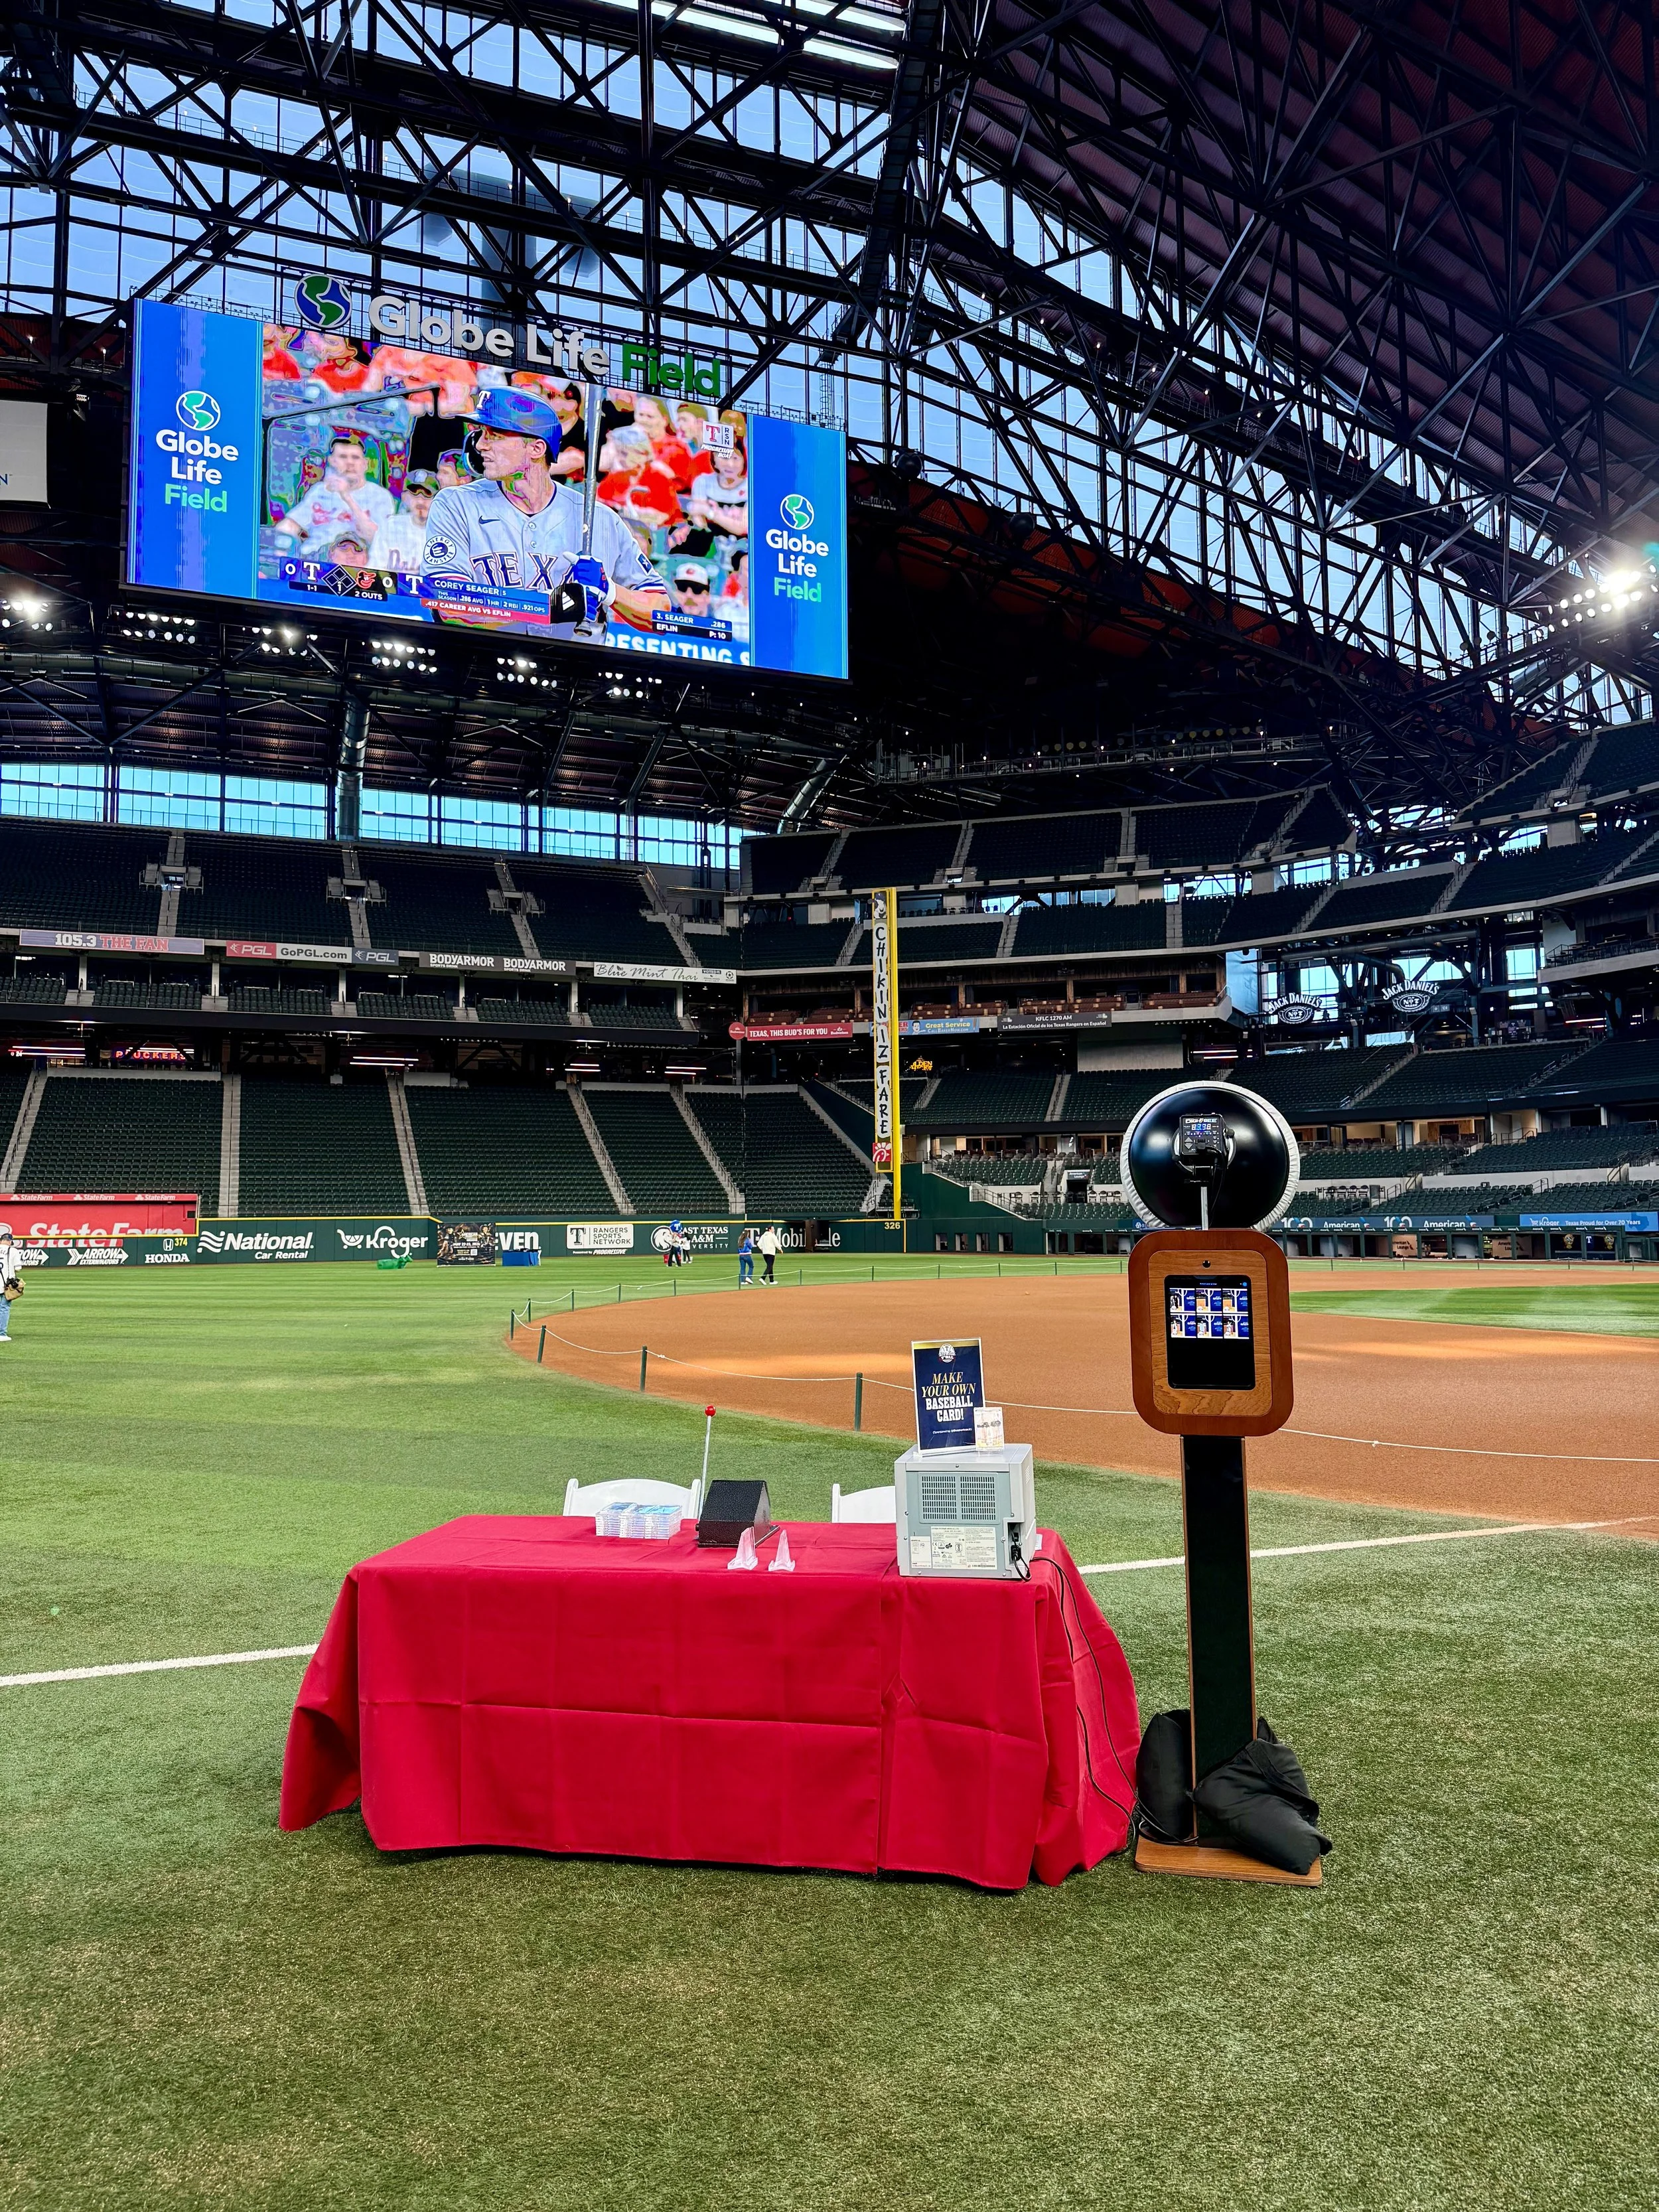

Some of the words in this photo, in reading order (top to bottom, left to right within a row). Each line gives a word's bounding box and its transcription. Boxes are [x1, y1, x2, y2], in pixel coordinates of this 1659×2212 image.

[368, 295, 515, 357] Globe
[527, 323, 610, 376] Life
[622, 342, 721, 398] Field
[476, 390, 491, 409] T
[705, 425, 721, 443] T
[156, 429, 239, 461] Globe
[171, 456, 222, 484] Life
[165, 483, 228, 512] Field
[426, 536, 454, 552] ENERGY
[765, 528, 830, 557] Globe
[425, 552, 455, 565] TRANSFER
[778, 553, 818, 578] Life
[285, 563, 296, 575] 0
[303, 561, 321, 581] T
[470, 552, 575, 590] TEX
[382, 576, 393, 588] 0
[405, 575, 423, 595] T
[434, 579, 464, 591] COREY
[466, 583, 499, 595] SEAGER
[361, 591, 383, 601] OUTS
[774, 577, 822, 603] Field
[439, 603, 467, 611] CAREER
[665, 614, 694, 624] SEAGER
[656, 623, 678, 632] EFLIN
[55, 933, 97, 947] 105.3
[100, 935, 132, 949] THE
[135, 936, 169, 951] FAN
[241, 944, 273, 956] PGL
[281, 947, 348, 960] GoPGL.com
[366, 952, 396, 963] PGL
[429, 953, 494, 967] BODYARMOR
[503, 958, 566, 972] BODYARMOR
[596, 964, 628, 977] Blue
[629, 966, 668, 978] Mint
[672, 968, 699, 980] Thai
[875, 926, 887, 1020] CHIKIN
[1382, 983, 1404, 1000] JACK
[1404, 980, 1440, 995] DANIEL'S
[1269, 995, 1289, 1014] JACK
[1289, 992, 1322, 1008] DANIEL'S
[877, 1029, 889, 1059] IZ
[115, 1051, 186, 1060] PUCKERS
[879, 1069, 889, 1135] FARE
[1539, 1217, 1559, 1226] Kroger
[175, 1238, 188, 1246] 374
[366, 1226, 429, 1259] Kroger
[570, 1228, 586, 1245] T
[691, 1234, 714, 1243] A&M
[82, 1248, 119, 1259] ARROW
[145, 1254, 190, 1264] HONDA
[255, 1251, 273, 1260] Car
[275, 1250, 308, 1260] Rental
[932, 1371, 964, 1385] MAKE
[921, 1385, 950, 1398] YOUR
[952, 1383, 977, 1395] OWN
[926, 1395, 974, 1410] BASEBALL
[936, 1408, 964, 1422] CARD!
